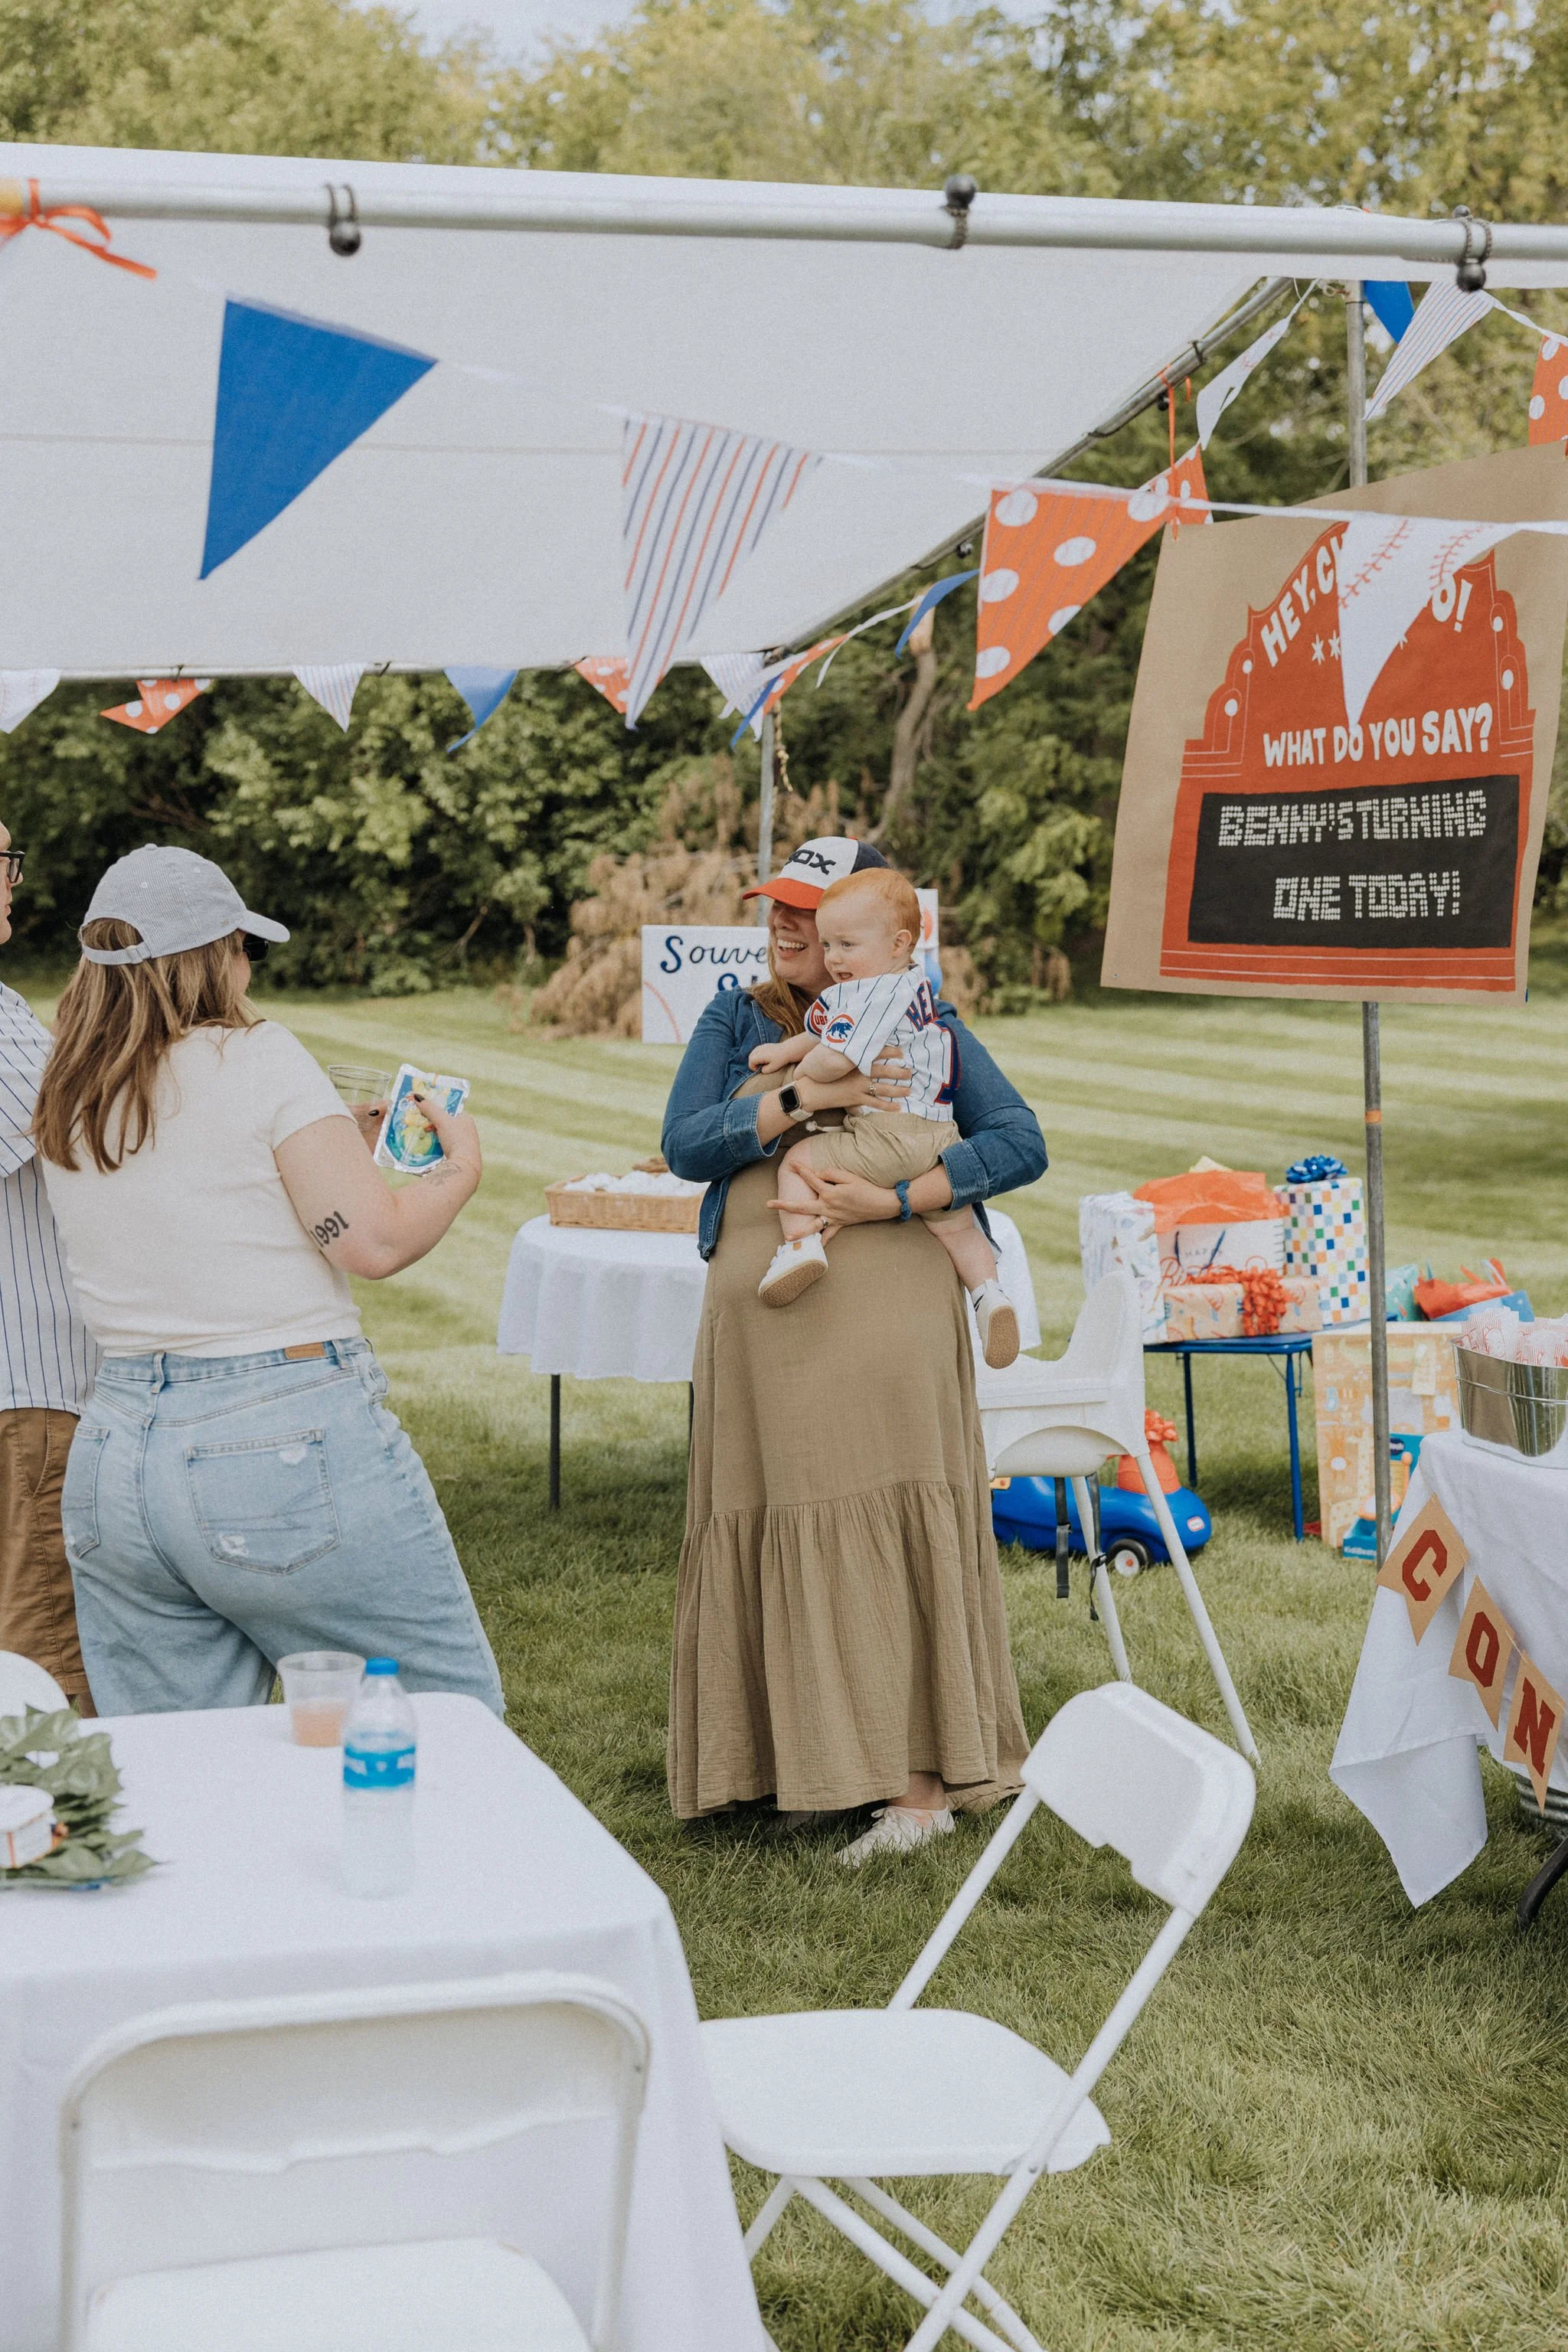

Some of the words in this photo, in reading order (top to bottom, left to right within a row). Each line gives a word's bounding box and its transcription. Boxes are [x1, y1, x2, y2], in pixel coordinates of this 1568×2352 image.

[1261, 565, 1316, 668] HEY,
[1263, 728, 1327, 767] WHAT
[1334, 723, 1364, 763] DO
[1369, 717, 1416, 761] YOU
[1422, 702, 1493, 755] SAY?
[1219, 802, 1354, 846] BENNY'S
[1356, 789, 1487, 840] TURNING
[1272, 876, 1341, 921] ONE
[1349, 871, 1461, 919] TODAY!
[309, 1210, 349, 1248] 1991
